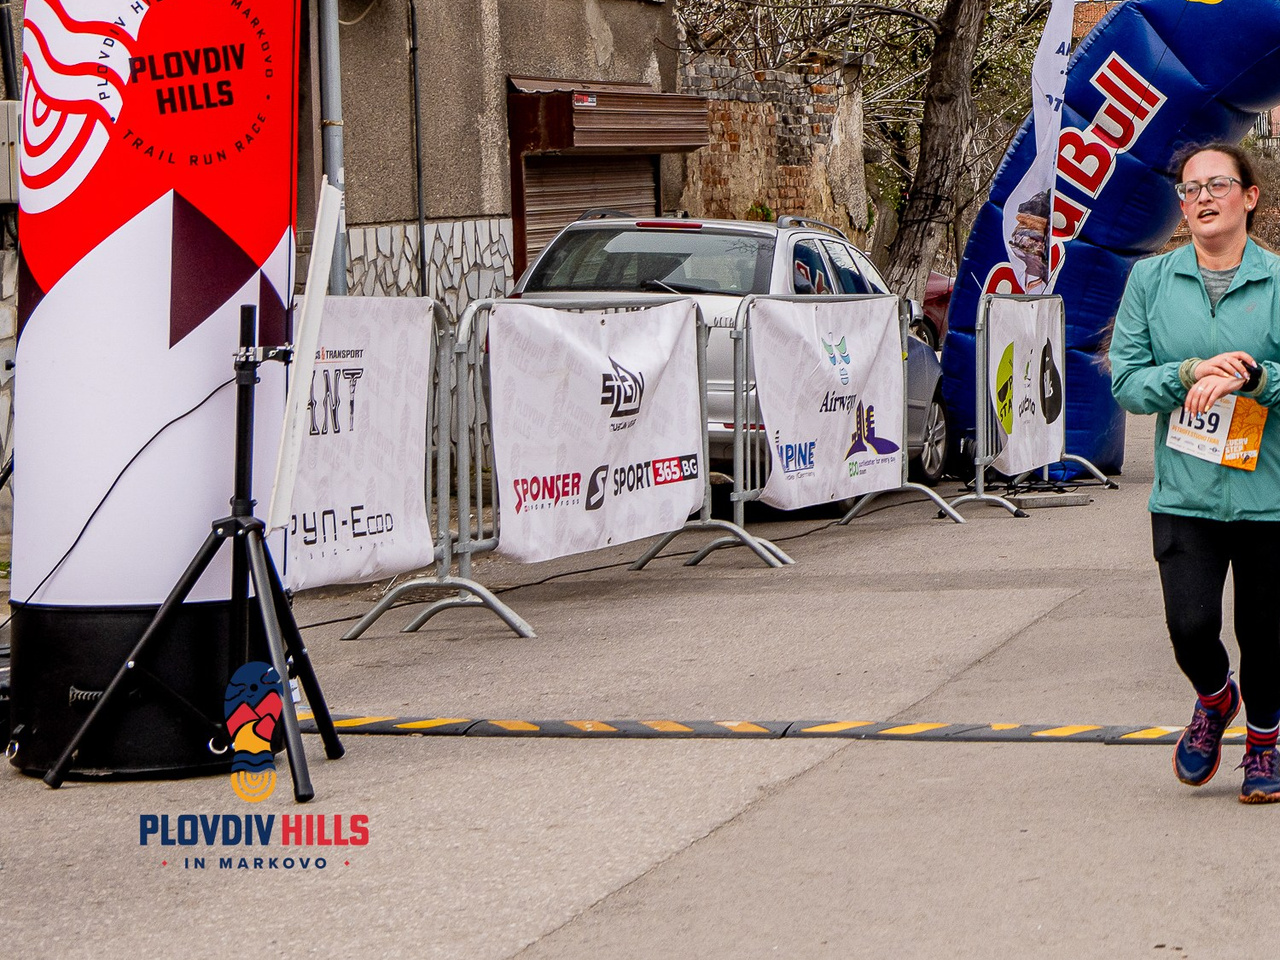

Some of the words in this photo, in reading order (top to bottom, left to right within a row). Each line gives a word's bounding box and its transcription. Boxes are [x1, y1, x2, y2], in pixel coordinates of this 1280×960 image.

[97, 16, 126, 101] PLOVDIV
[128, 43, 245, 84] PLOVDIV
[155, 79, 235, 116] HILLS
[122, 128, 176, 164] TRAIL
[189, 149, 227, 166] RUN
[234, 112, 267, 152] RACE
[1055, 55, 1161, 194] Bull
[325, 348, 364, 360] TRANSPORT
[513, 472, 582, 515] SPONSER
